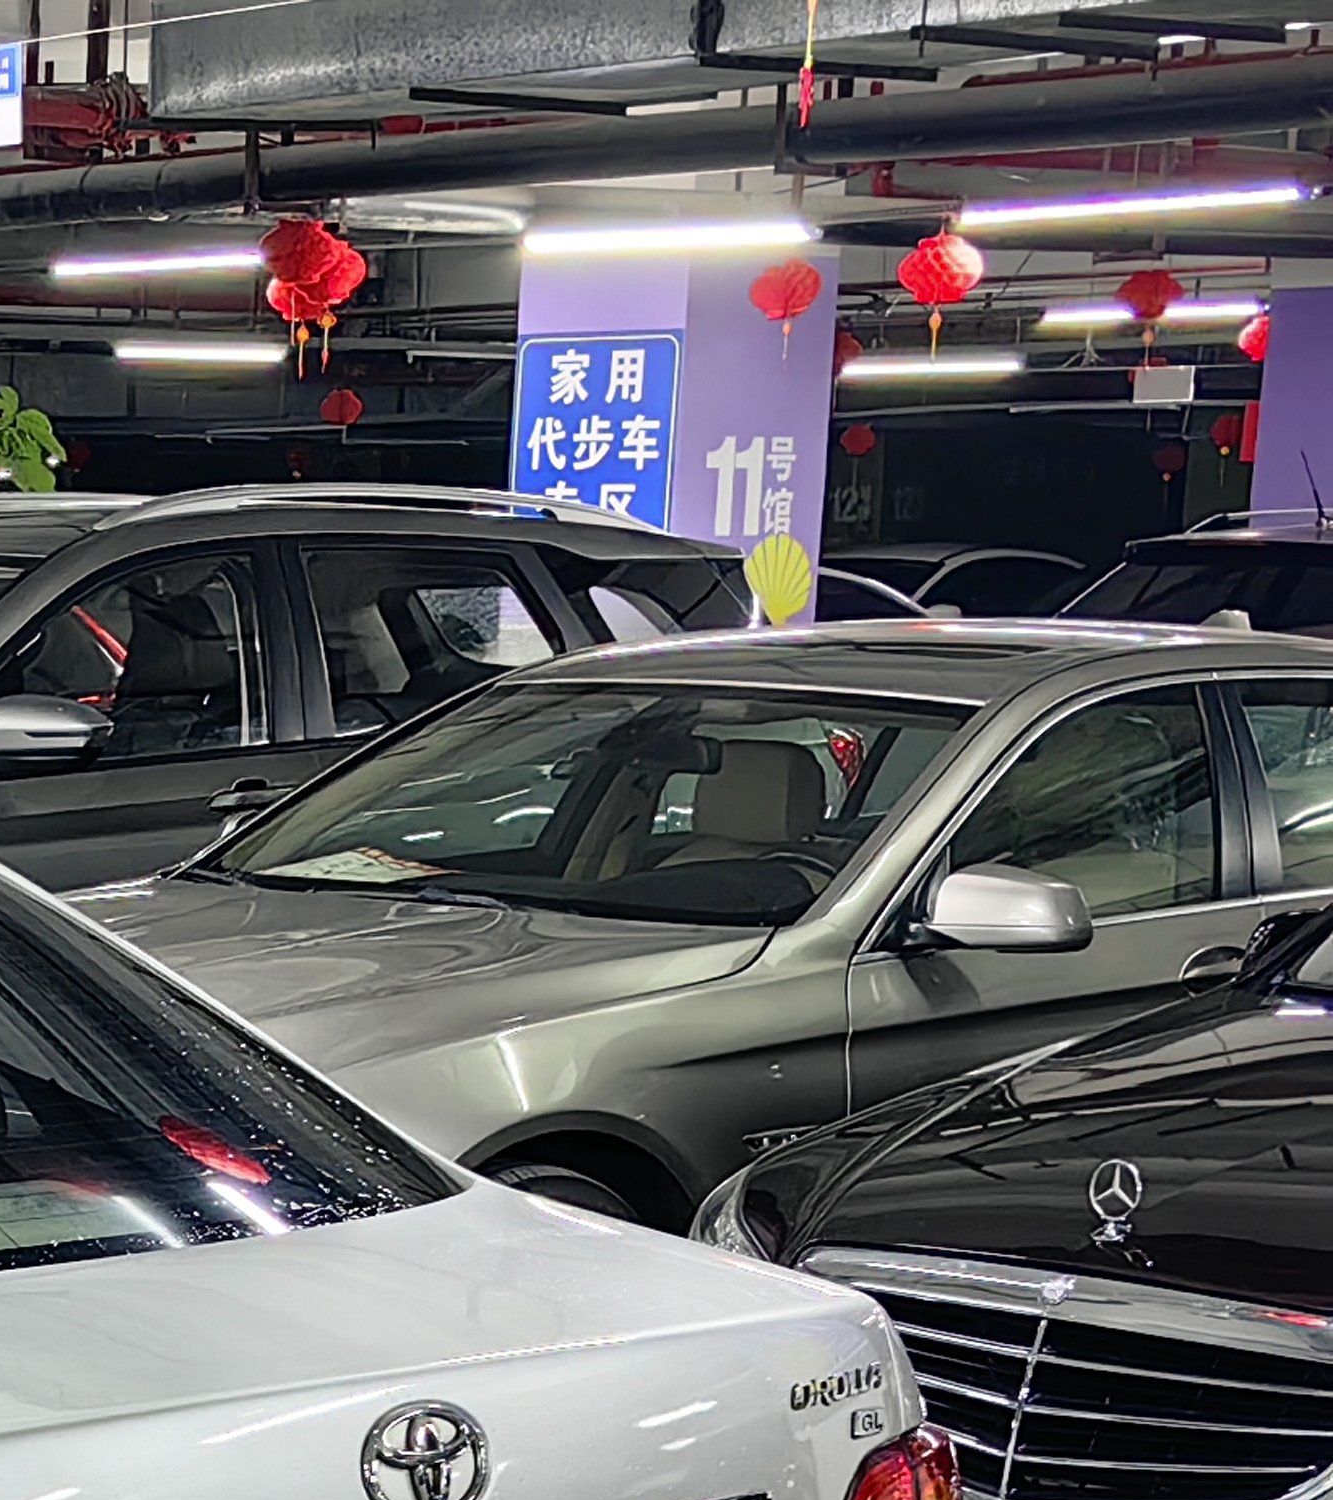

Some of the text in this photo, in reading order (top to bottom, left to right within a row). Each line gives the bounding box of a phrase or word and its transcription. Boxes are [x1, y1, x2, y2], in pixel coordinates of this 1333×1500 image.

[549, 349, 646, 405] 家用
[527, 414, 660, 471] 代步车
[862, 1412, 883, 1432] GL
